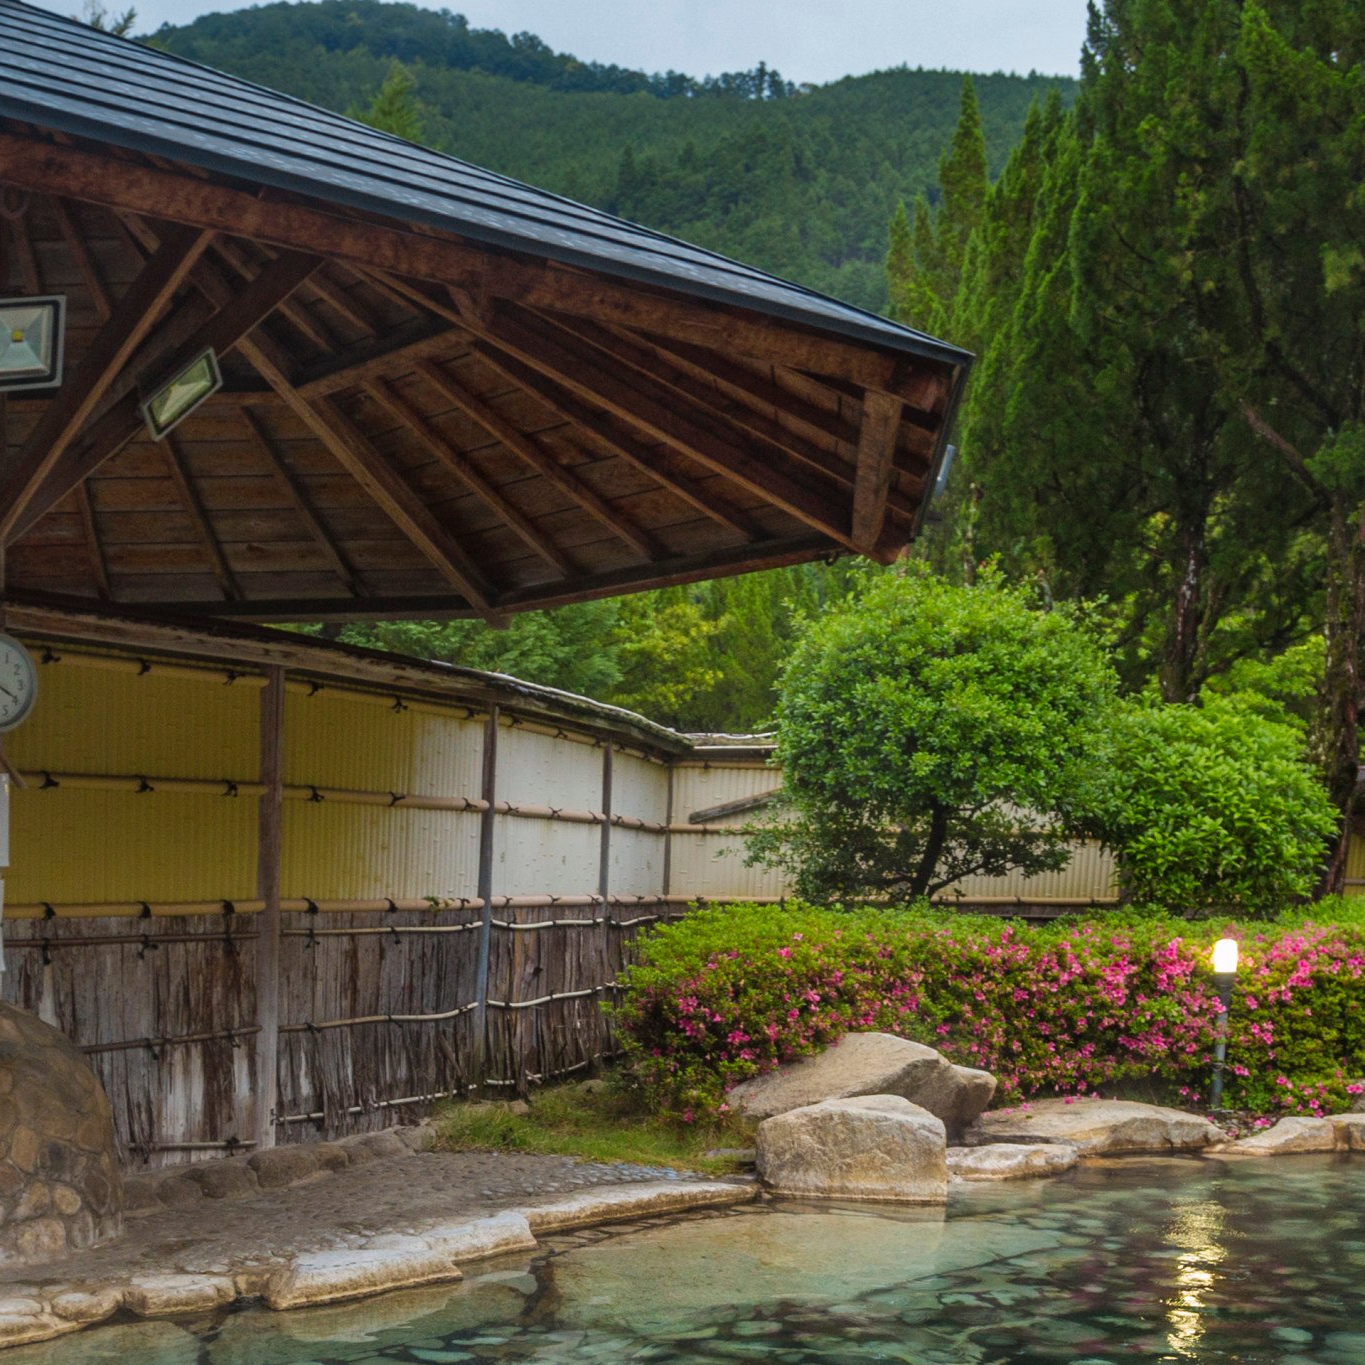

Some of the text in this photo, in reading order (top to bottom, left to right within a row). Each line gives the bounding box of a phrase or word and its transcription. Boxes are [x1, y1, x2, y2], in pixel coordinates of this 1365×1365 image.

[4, 650, 10, 664] 1
[14, 663, 20, 675] 2
[17, 678, 24, 691] 3
[11, 695, 18, 706] 4
[2, 705, 8, 716] 5
